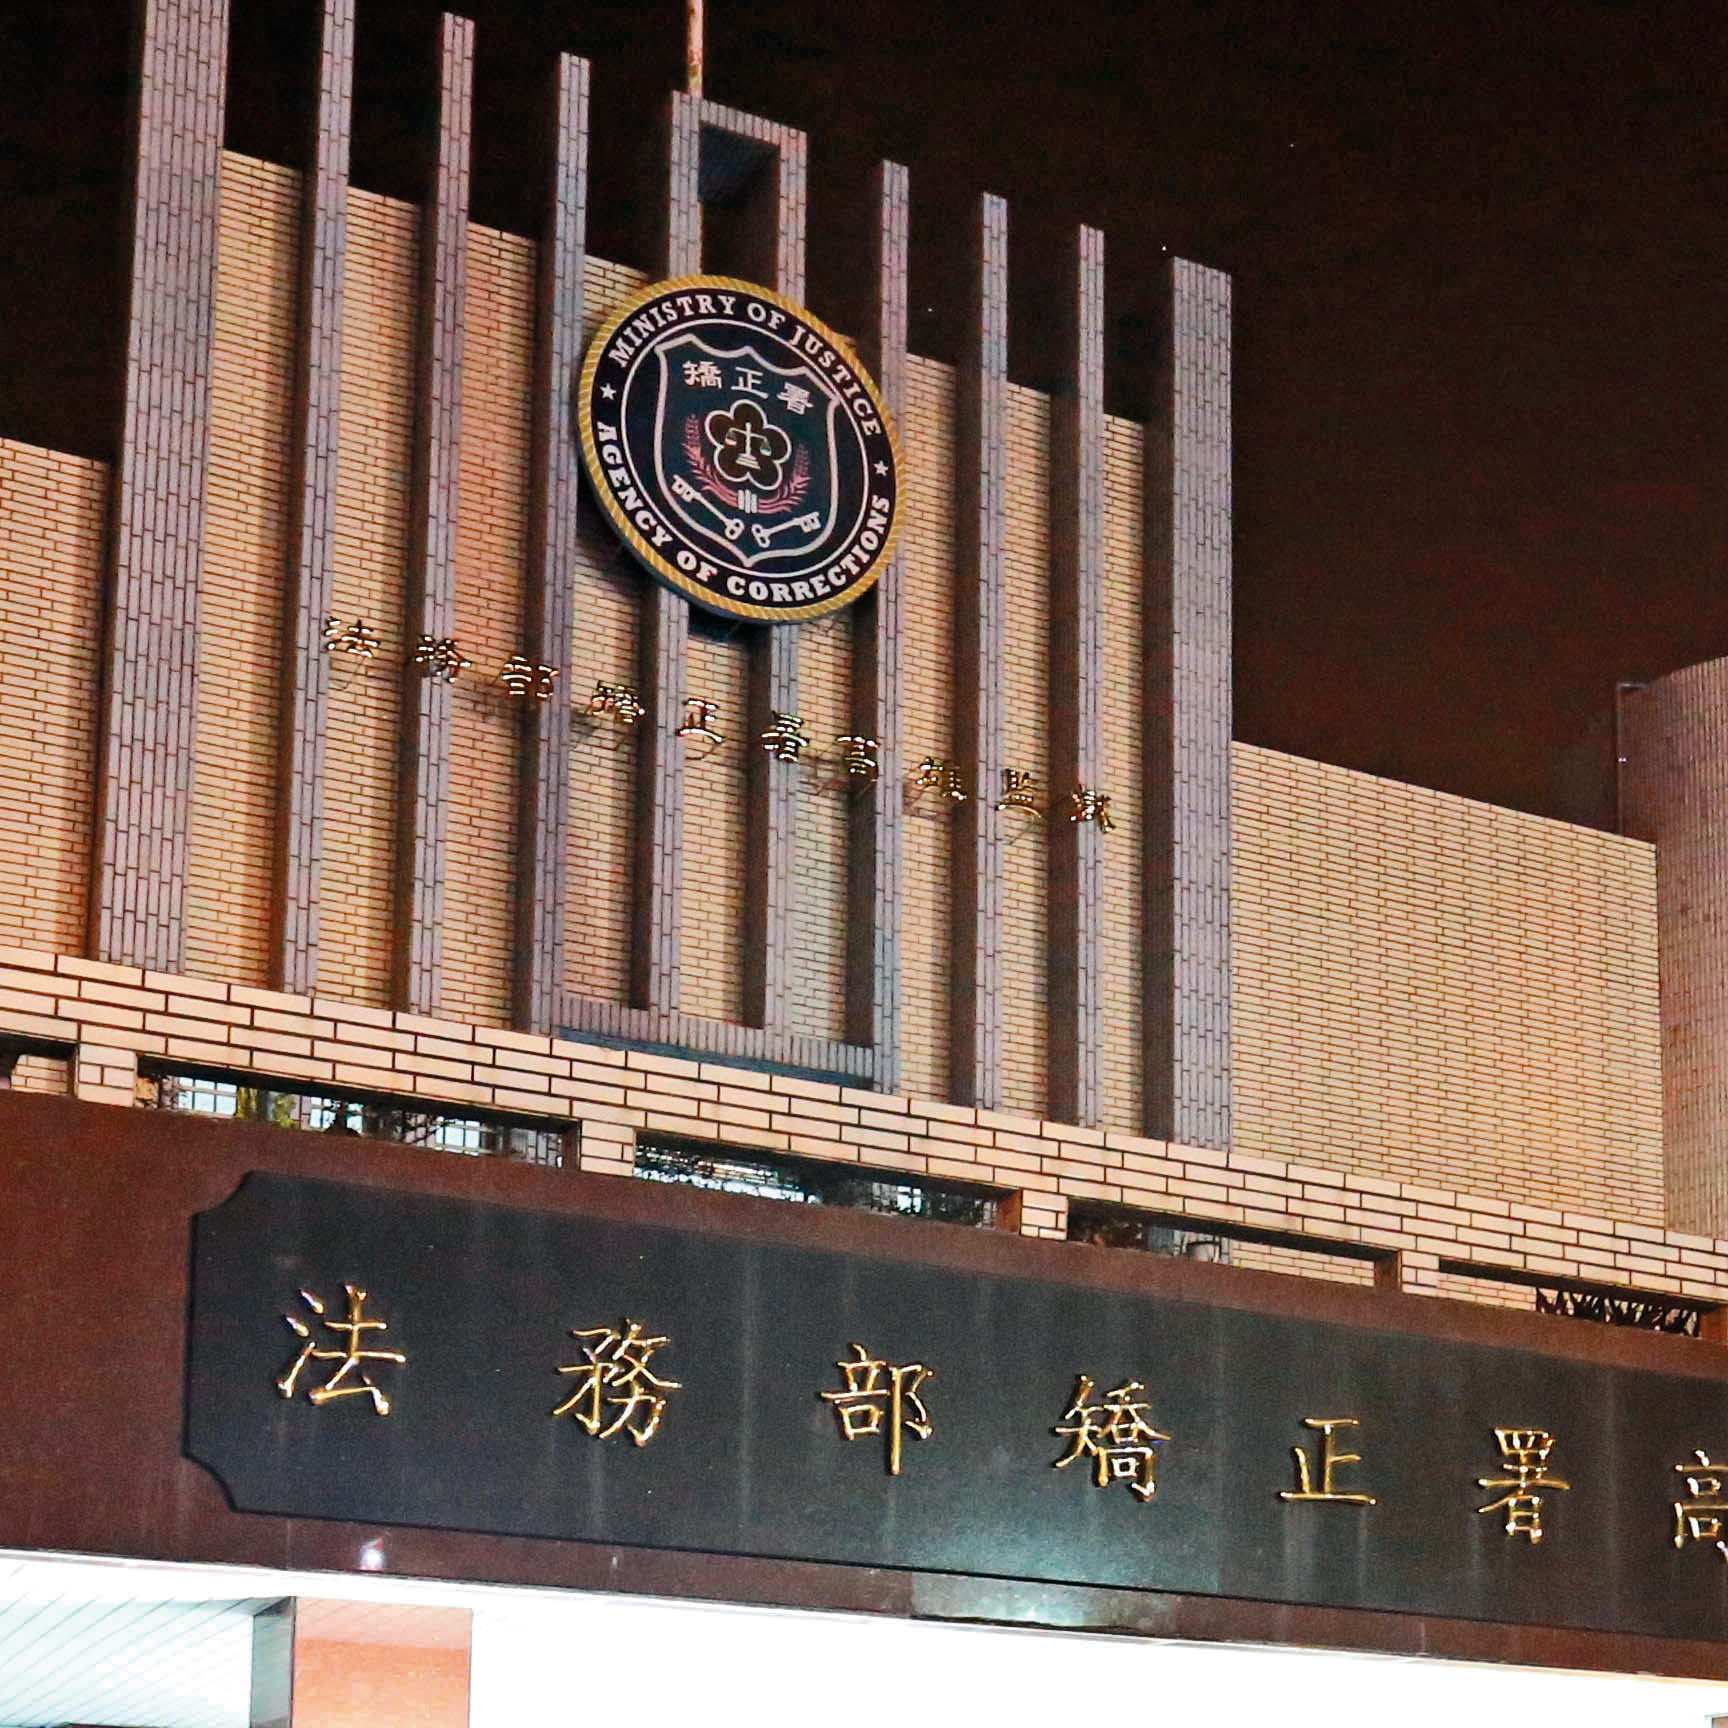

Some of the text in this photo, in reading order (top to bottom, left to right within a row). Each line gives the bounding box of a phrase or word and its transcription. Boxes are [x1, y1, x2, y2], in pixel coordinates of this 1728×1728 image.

[607, 294, 882, 438] MINISTRY OF JUSTICE
[681, 359, 815, 415] 矯正署
[596, 420, 891, 602] AGENCY OF CORRECTIONS
